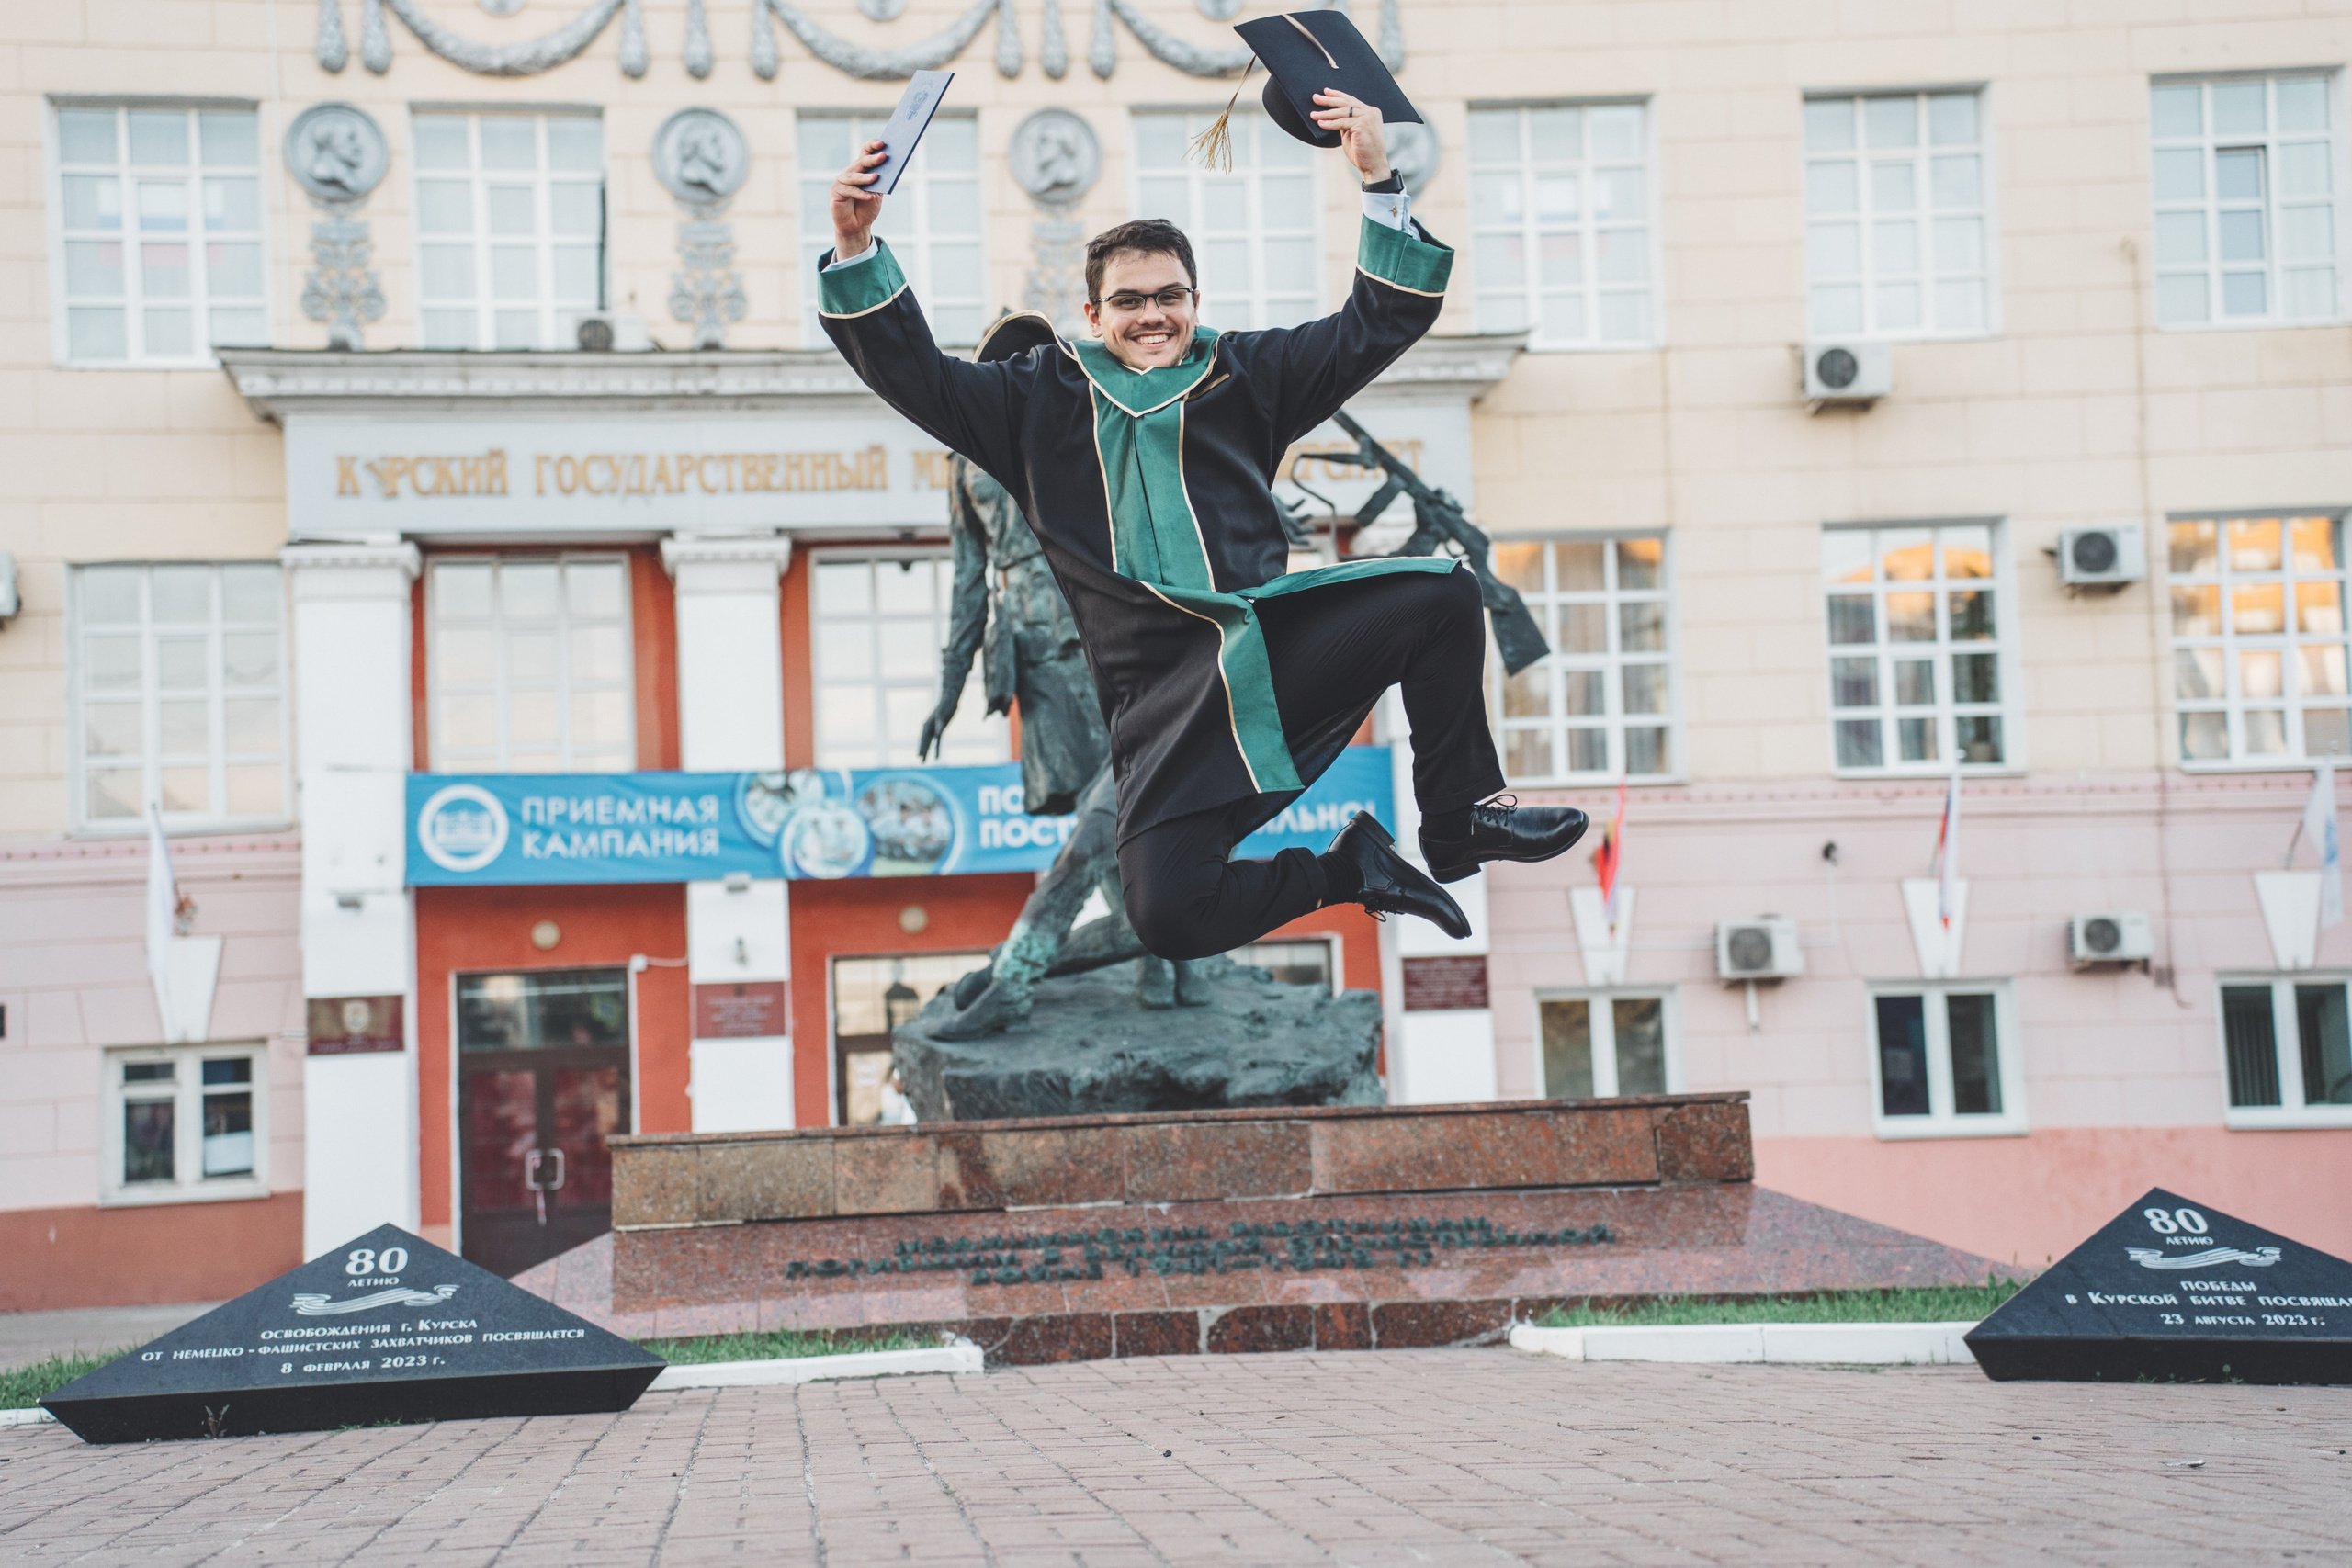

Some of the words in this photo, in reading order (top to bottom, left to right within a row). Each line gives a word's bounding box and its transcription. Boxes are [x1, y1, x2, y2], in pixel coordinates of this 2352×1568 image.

[336, 447, 508, 496] КУРСКИЙ
[535, 445, 888, 496] ГОСУДАРСТВЕННЫЙ
[521, 795, 720, 825] ПРИЕМНАЯ
[521, 827, 720, 860] КАМПАНИЯ
[979, 816, 1078, 849] ПОСТ
[2143, 1207, 2209, 1235] 80
[2165, 1235, 2214, 1246] ЛЕТИЮ
[345, 1247, 409, 1276] 80
[347, 1276, 400, 1288] ЛЕТИЮ
[2179, 1280, 2257, 1292] ПОБЕДЫ
[2189, 1295, 2247, 1306] БИТВЕ
[2257, 1295, 2352, 1307] ПОСВЯЩА
[260, 1324, 391, 1340] ОСВОБОЖДЕНИЯ
[418, 1318, 478, 1332] КУРСКА
[2160, 1313, 2185, 1325] 23
[2194, 1315, 2256, 1325] АВГУСТА
[141, 1350, 164, 1362] ОТ
[370, 1334, 473, 1349] ЗАХВАТЧИКОВ
[280, 1362, 293, 1374] 8
[302, 1360, 371, 1373] ФЕВРАЛЯ
[380, 1354, 427, 1369] 2023
